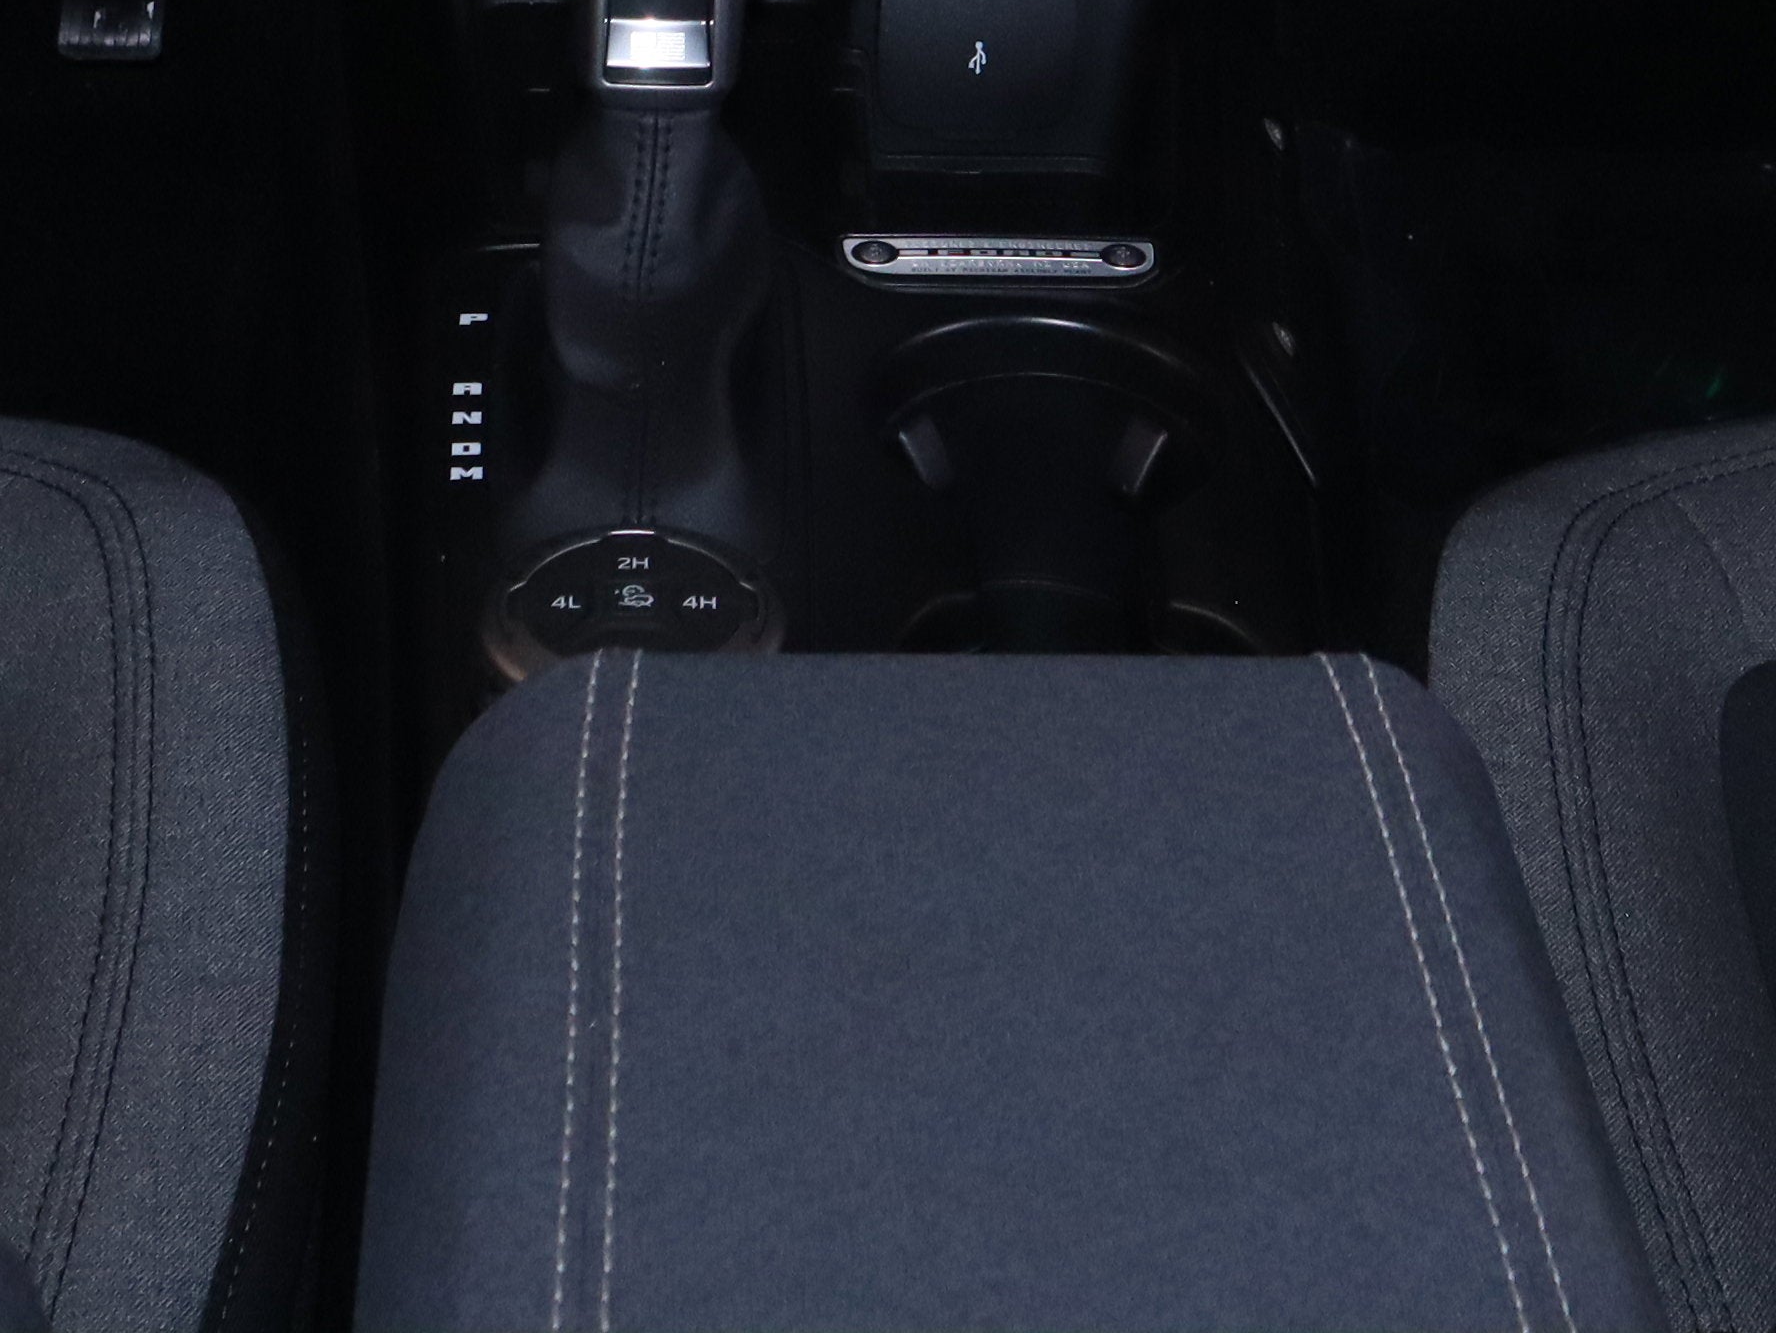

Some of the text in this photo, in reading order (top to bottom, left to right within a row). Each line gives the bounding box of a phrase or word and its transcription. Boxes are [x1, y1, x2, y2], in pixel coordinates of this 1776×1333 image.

[459, 313, 488, 326] P
[451, 411, 482, 425] N
[451, 442, 482, 456] D
[449, 466, 484, 481] M
[617, 556, 650, 570] 2H
[550, 595, 581, 609] 4L
[682, 595, 718, 610] 4H
